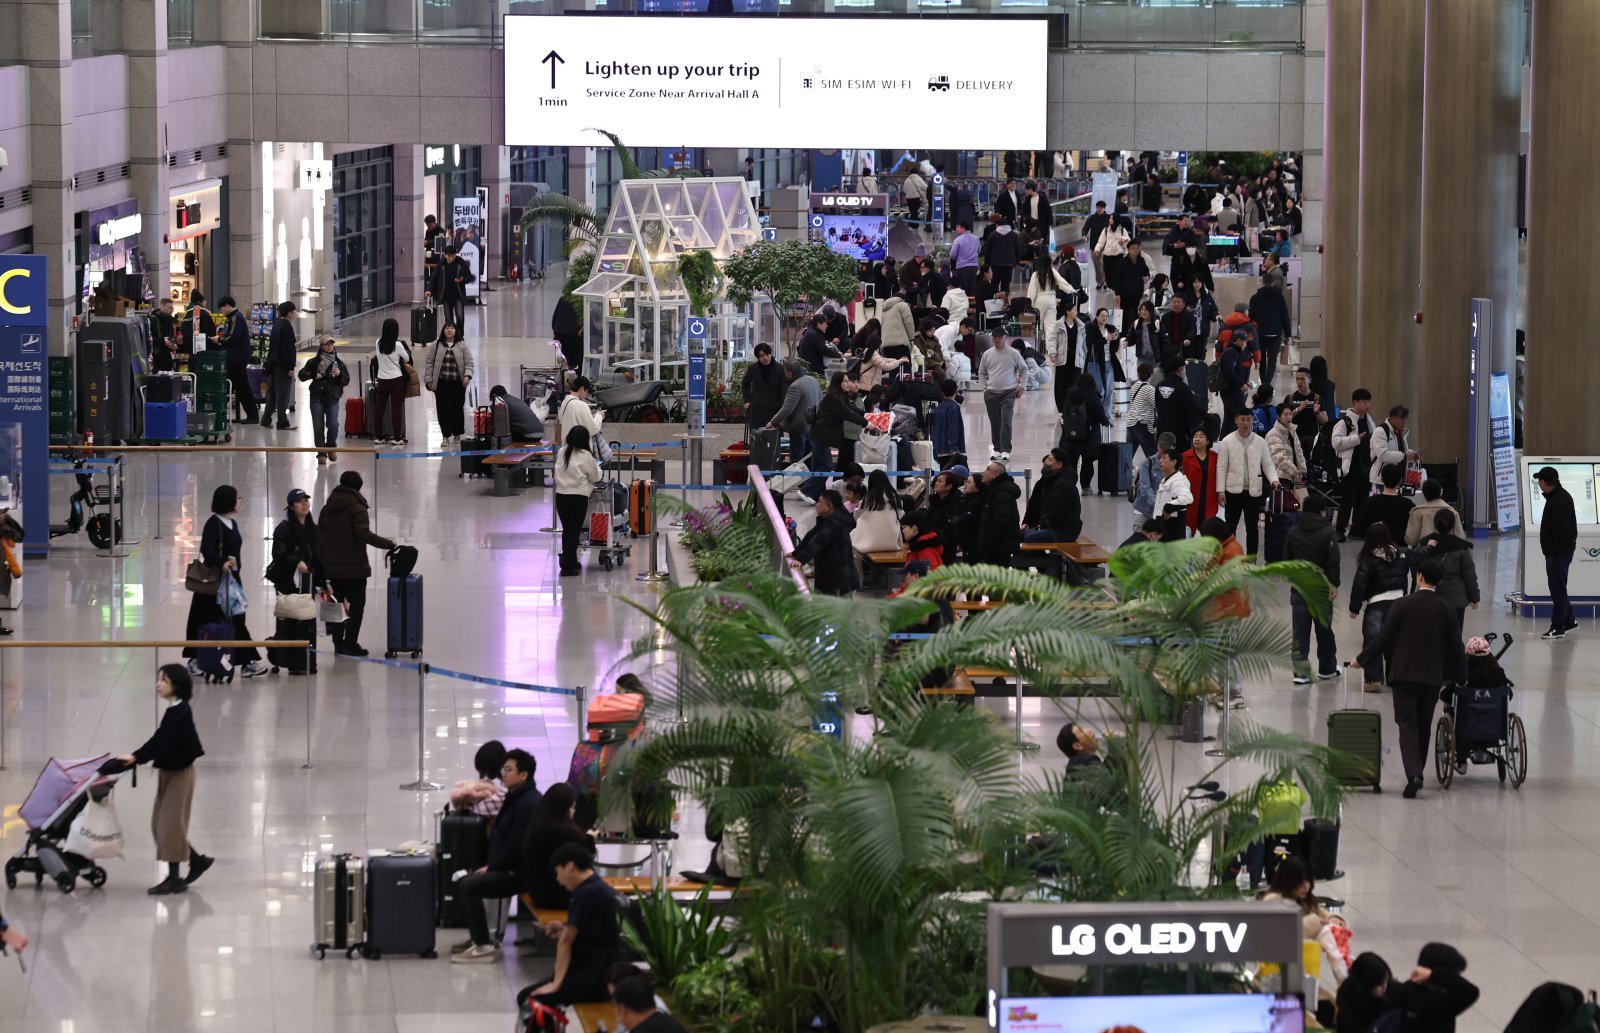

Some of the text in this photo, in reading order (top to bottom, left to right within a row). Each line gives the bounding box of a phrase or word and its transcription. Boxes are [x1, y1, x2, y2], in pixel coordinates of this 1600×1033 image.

[585, 60, 760, 81] Lighten up your trip
[956, 80, 1014, 90] DELIVERY
[586, 88, 760, 99] Service Zone Near Arrival Hall A
[538, 96, 568, 107] 1min
[822, 196, 874, 206] LG OLED TV
[454, 205, 479, 216] 두바이
[0, 268, 31, 315] C
[0, 396, 42, 404] ternational
[1051, 921, 1248, 956] LG OLED TV
